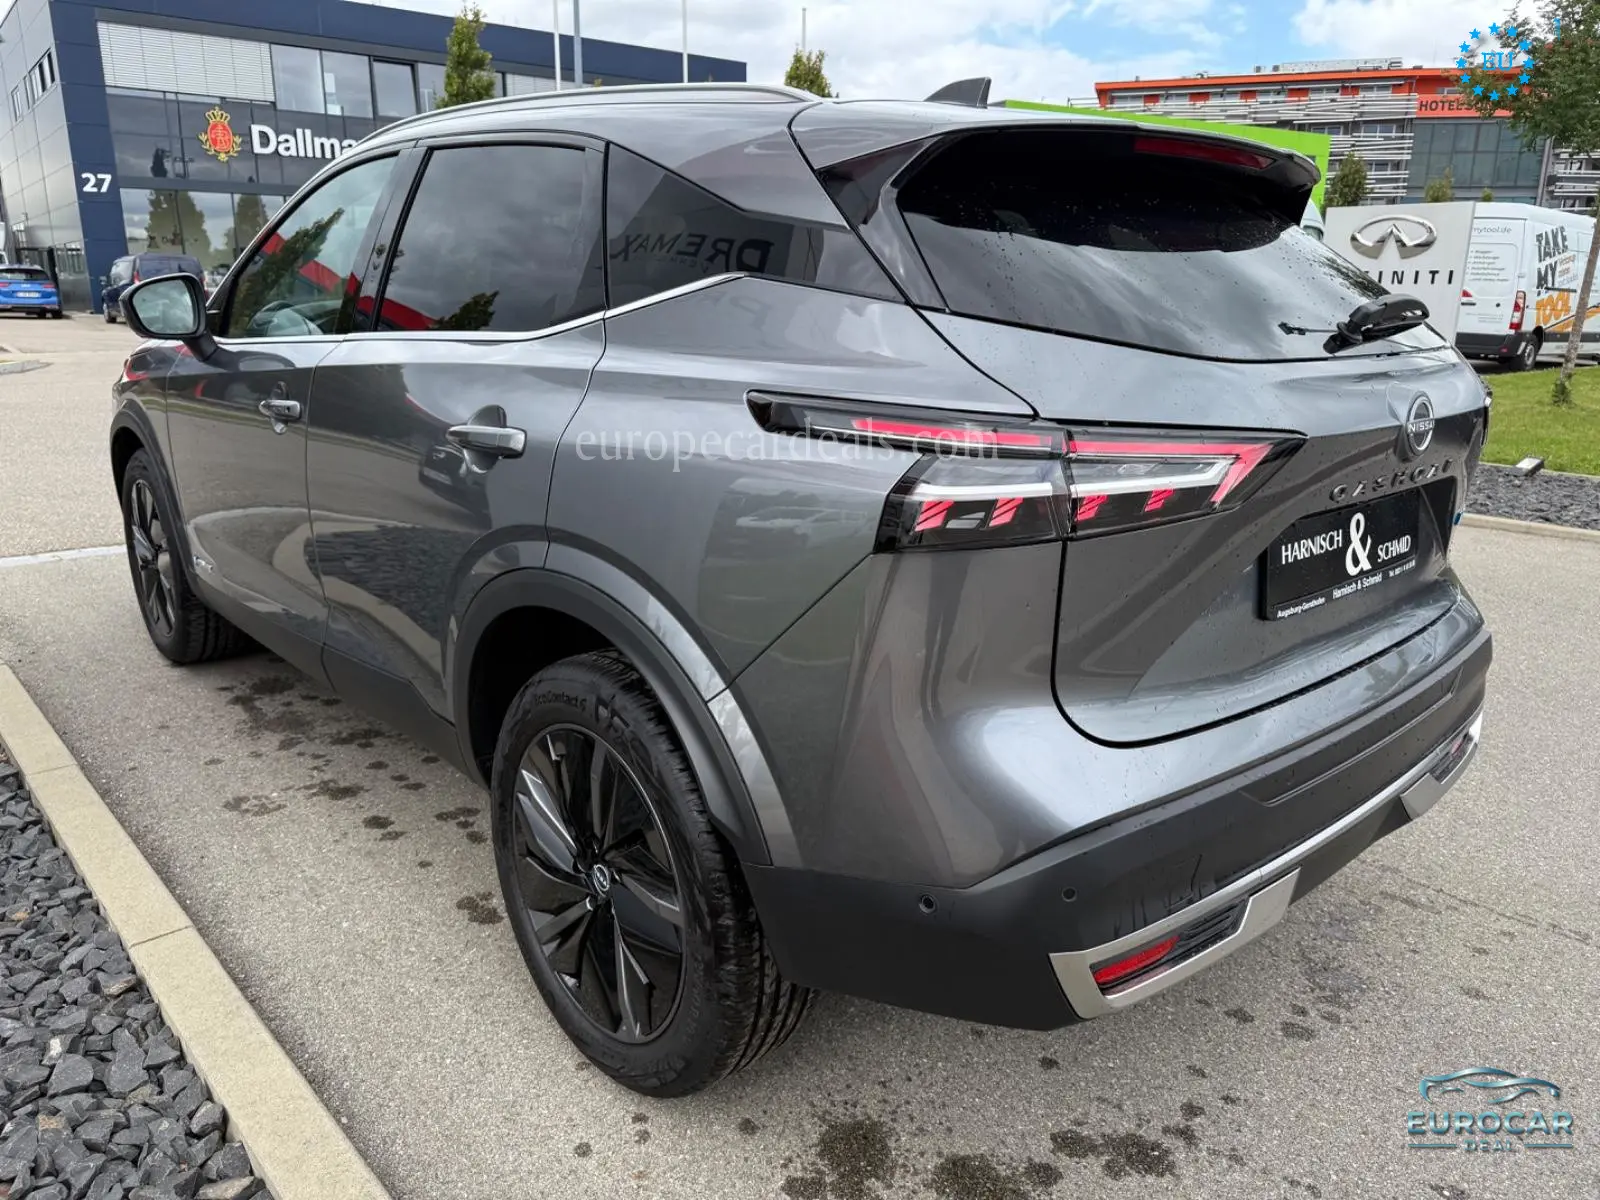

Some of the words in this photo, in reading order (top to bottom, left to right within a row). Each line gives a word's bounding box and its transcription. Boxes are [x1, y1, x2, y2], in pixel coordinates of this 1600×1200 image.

[250, 124, 358, 159] Dallma
[81, 173, 112, 193] 27
[1536, 226, 1569, 263] TAKE
[1366, 270, 1454, 285] INITI
[1537, 260, 1558, 289] MY
[1536, 291, 1571, 327] TOOL
[1281, 529, 1343, 565] HARNISCH
[1345, 512, 1372, 577] &
[1377, 534, 1412, 563] SCHMID
[1332, 582, 1356, 599] Harnisch
[1363, 572, 1383, 588] Schmid
